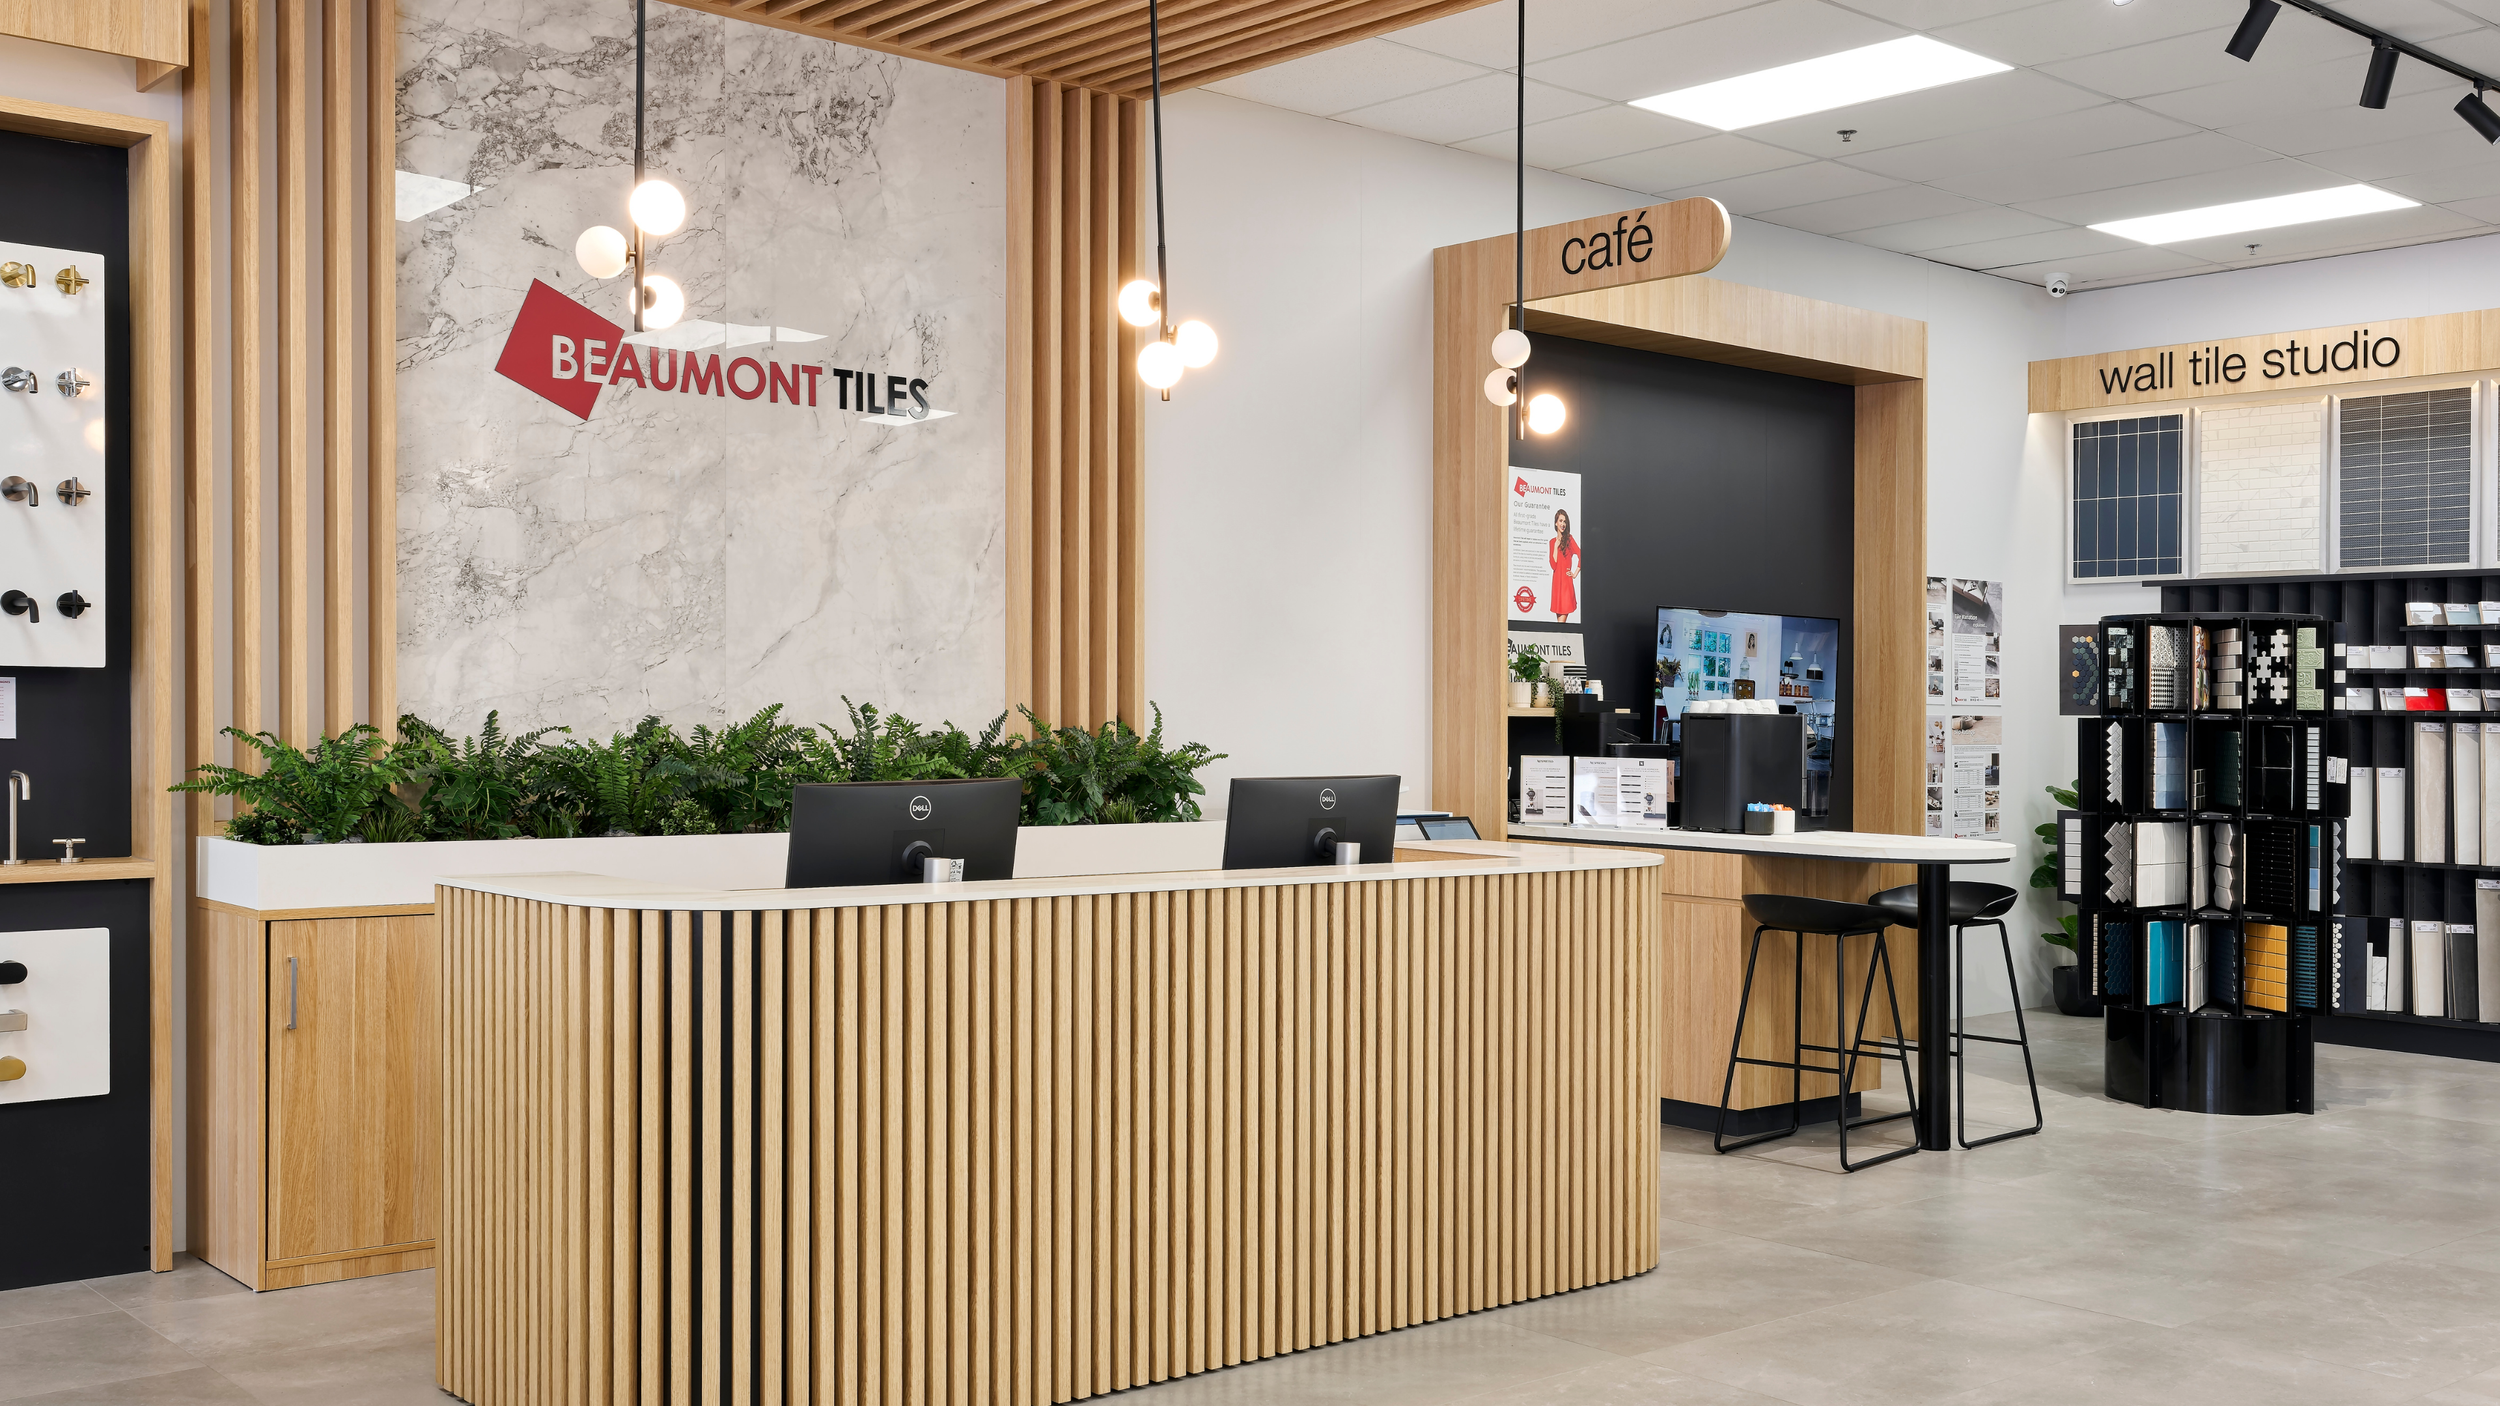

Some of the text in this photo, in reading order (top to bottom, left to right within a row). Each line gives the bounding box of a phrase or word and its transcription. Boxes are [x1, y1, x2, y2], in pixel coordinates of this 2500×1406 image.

[1561, 210, 1653, 275] café
[2099, 329, 2401, 395] wall tile studio
[551, 334, 930, 421] BEAUMONT TILES
[1519, 484, 1566, 497] BEAUMONT TILES
[1524, 501, 1551, 511] Guarantee
[1551, 645, 1572, 656] TILES
[912, 804, 929, 812] DELL
